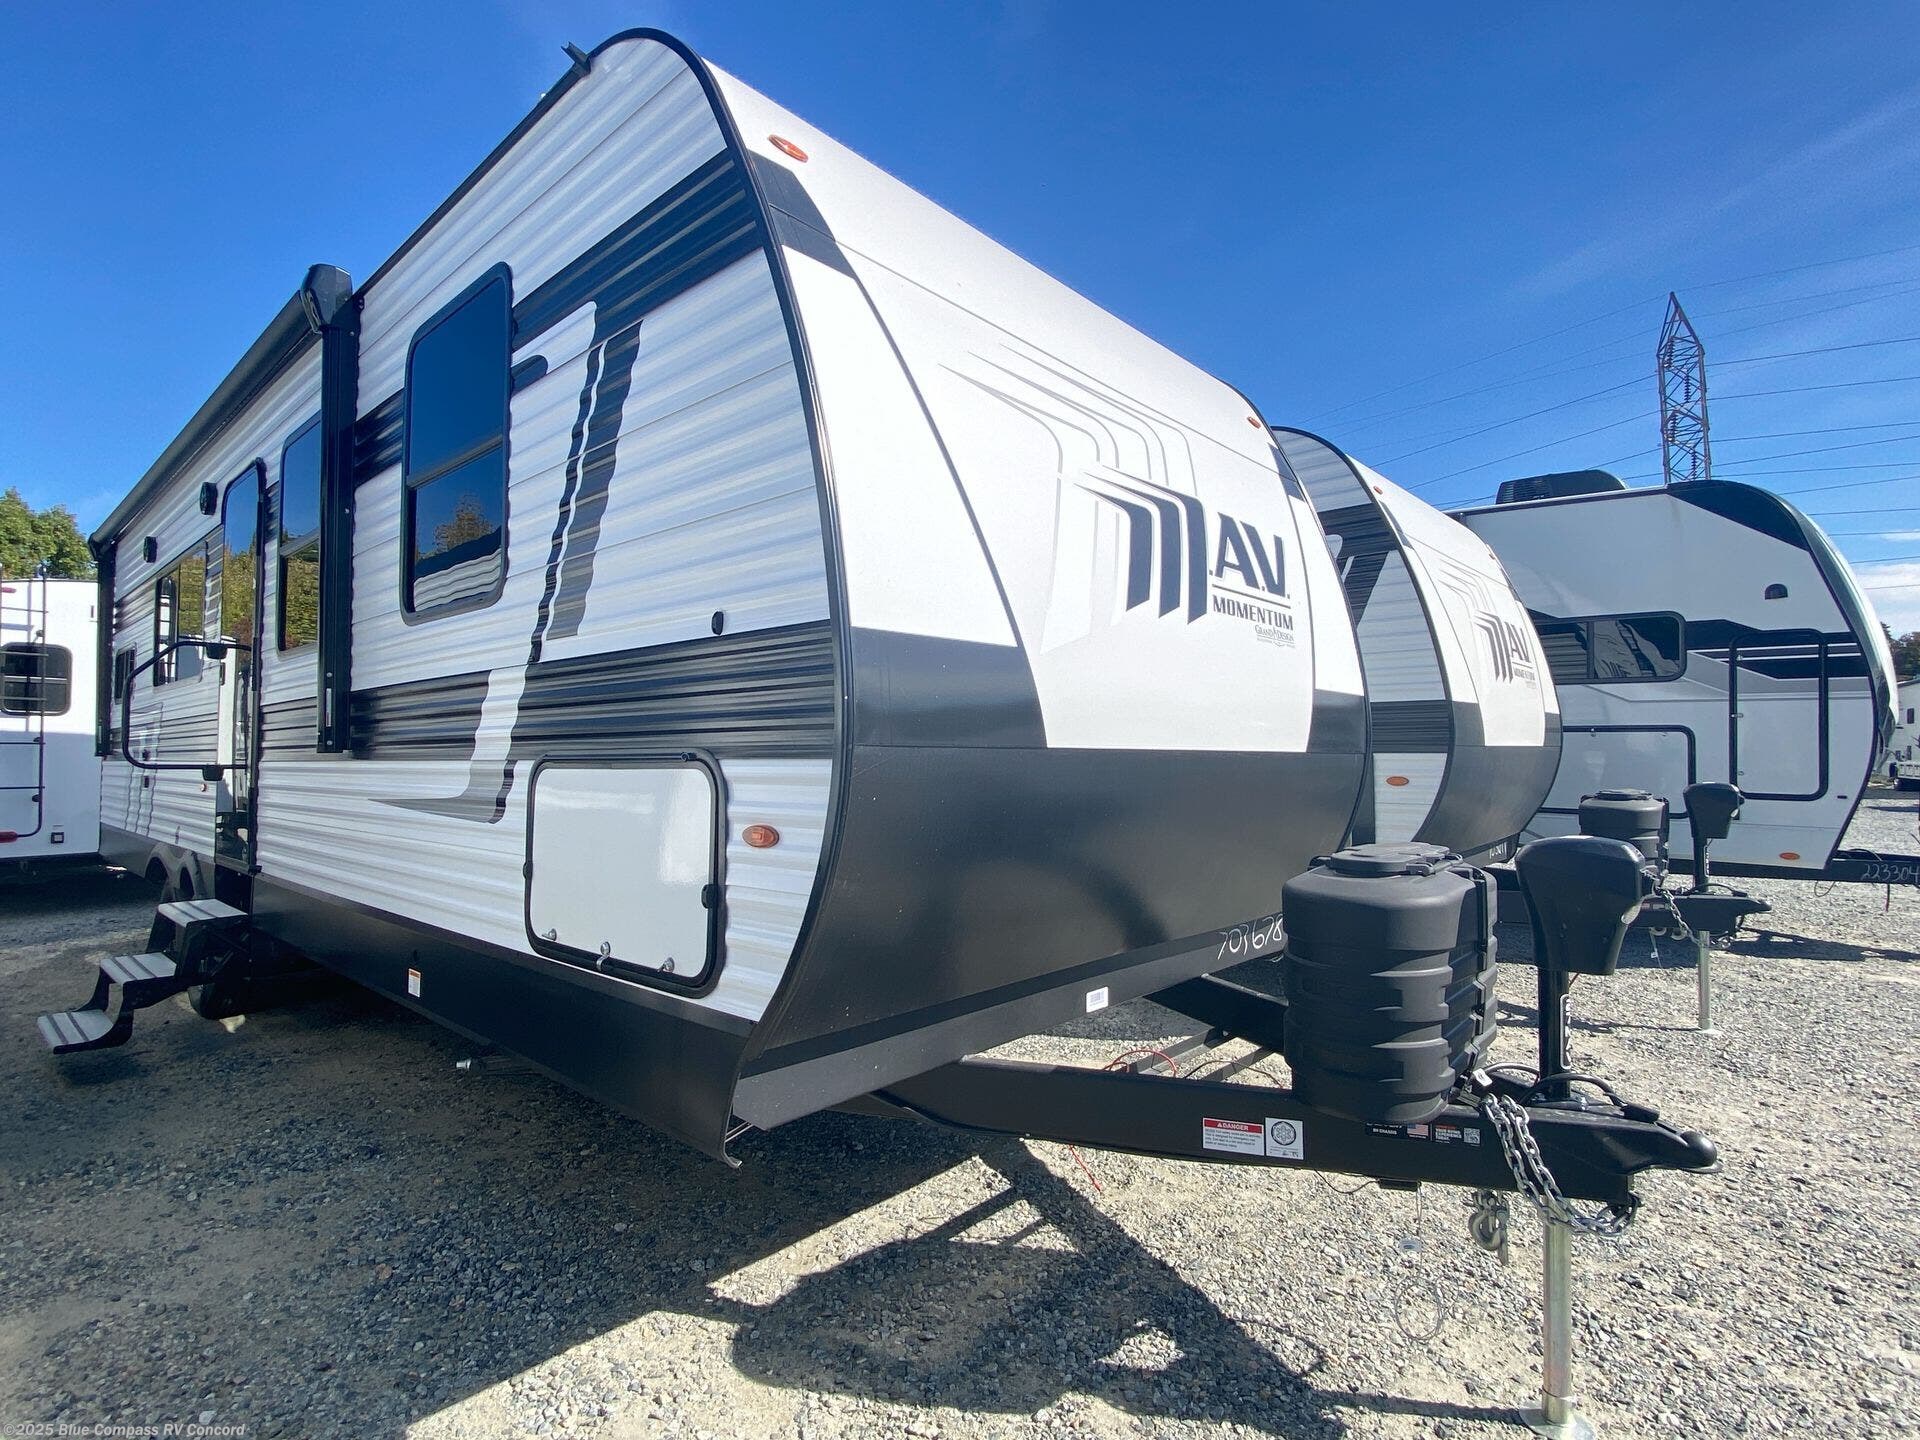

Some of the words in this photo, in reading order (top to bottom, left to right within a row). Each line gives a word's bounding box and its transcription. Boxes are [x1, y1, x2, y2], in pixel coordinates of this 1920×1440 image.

[1212, 594, 1294, 631] MOMENTUM
[1861, 863, 1920, 883] 223304
[1215, 914, 1284, 960] 703678
[1222, 1122, 1249, 1131] DANGER
